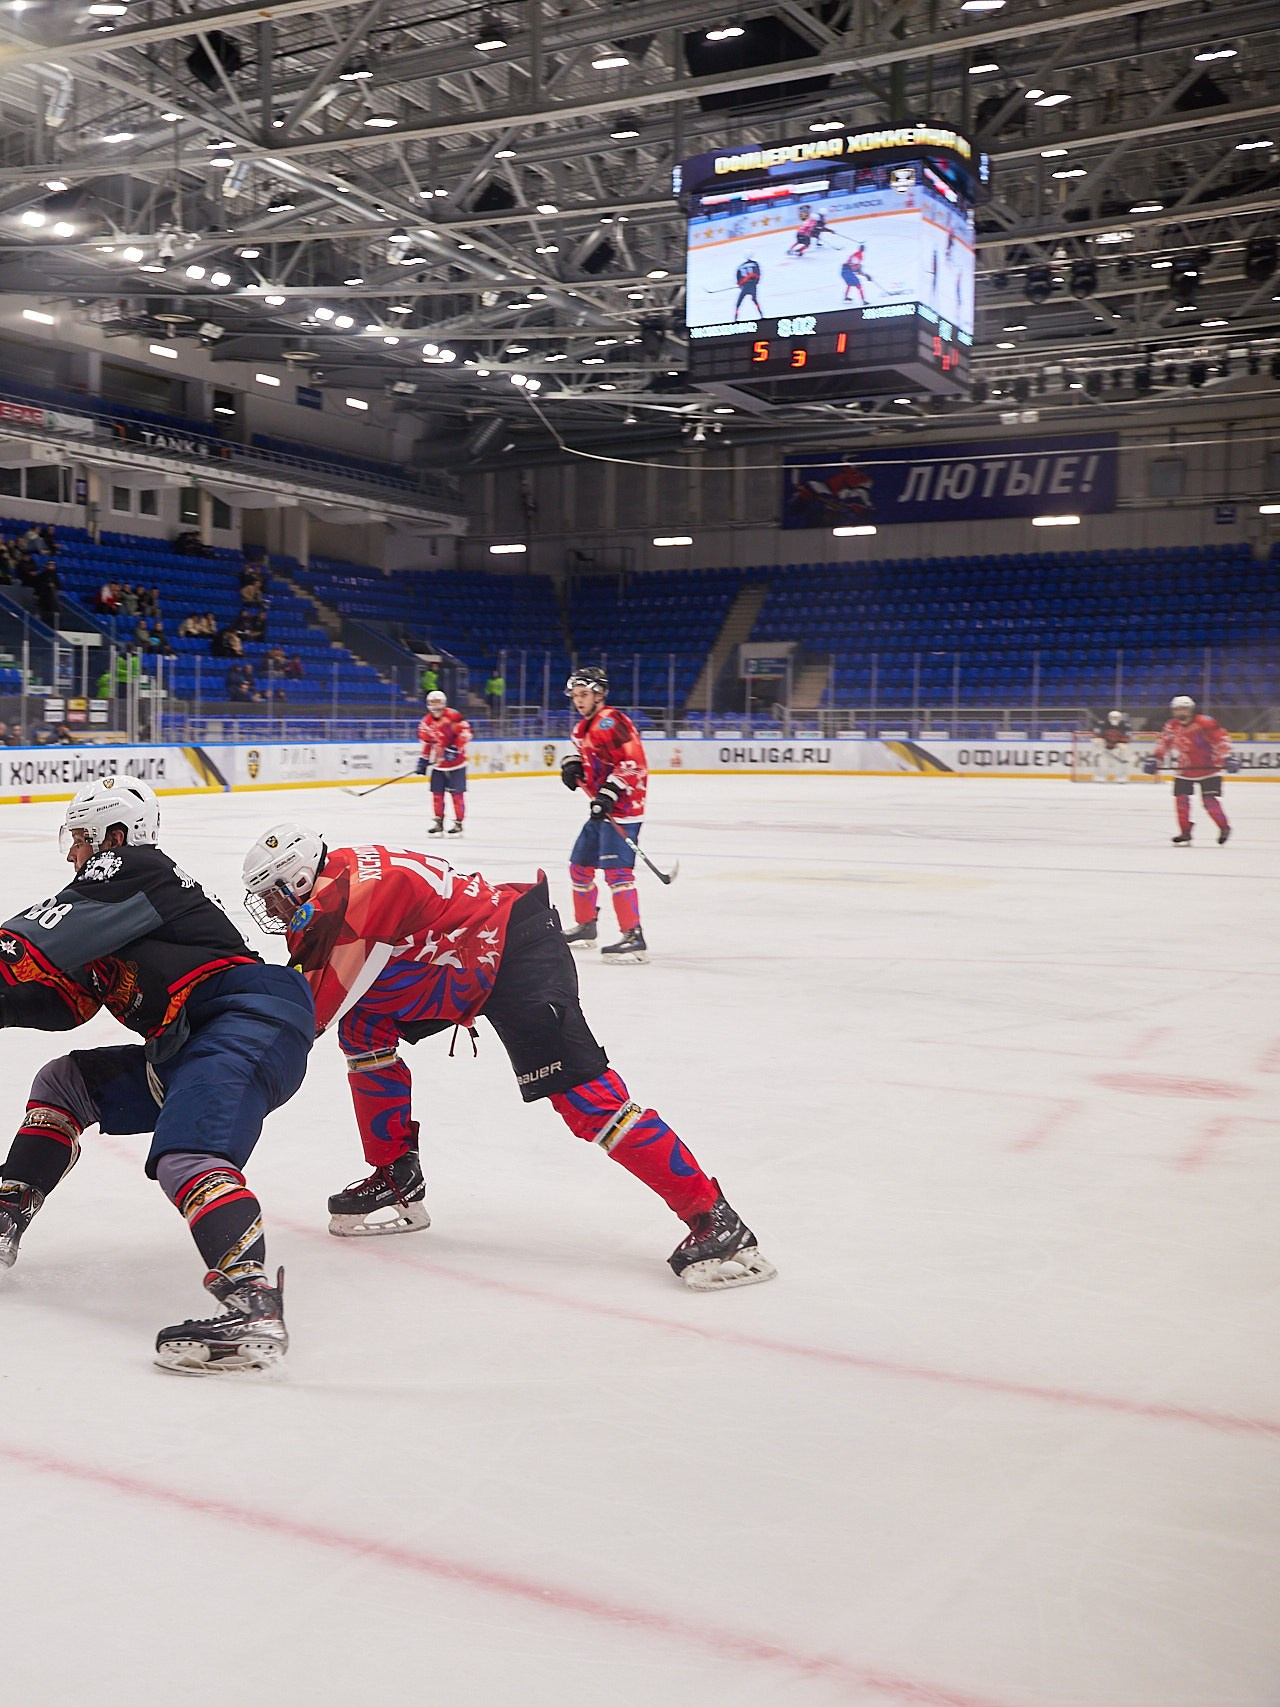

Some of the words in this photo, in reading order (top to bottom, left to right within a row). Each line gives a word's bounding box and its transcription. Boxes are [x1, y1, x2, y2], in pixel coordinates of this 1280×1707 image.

[752, 341, 771, 362] 5
[791, 350, 808, 368] 3
[898, 455, 1101, 502] ЛЮТЫЕ!
[720, 747, 831, 764] OHLIGA.RU
[10, 753, 117, 785] ХОККЕЙНАЯ
[125, 758, 166, 779] ЛИГА
[517, 1060, 563, 1085] BAUER
